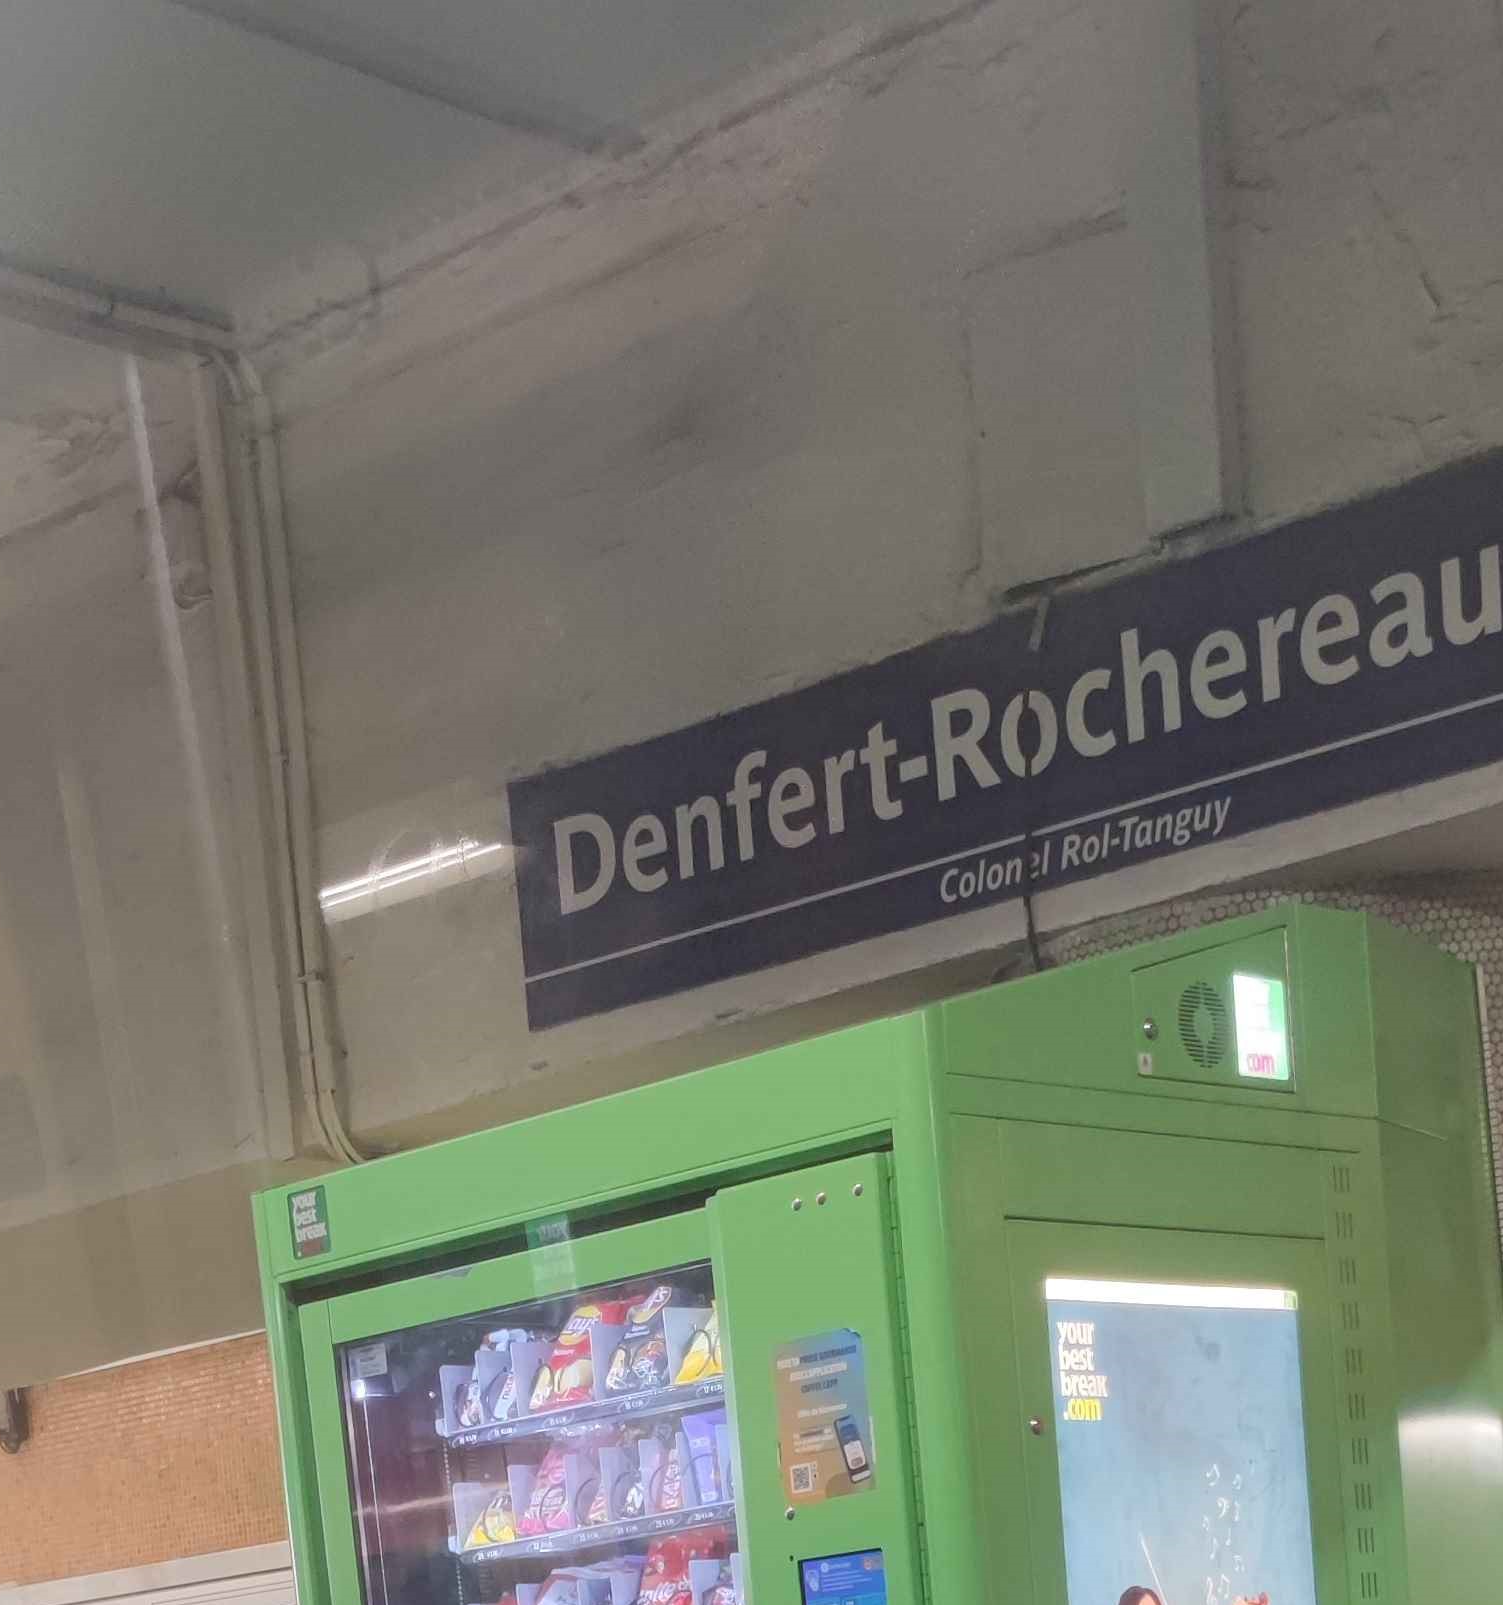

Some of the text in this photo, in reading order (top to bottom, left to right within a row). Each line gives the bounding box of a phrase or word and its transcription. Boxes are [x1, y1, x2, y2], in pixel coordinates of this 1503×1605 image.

[939, 796, 1232, 904] Colonel Rol-Tanguy
[1056, 1322, 1095, 1345] your
[1058, 1342, 1095, 1371] best
[1060, 1371, 1108, 1397] break
[1064, 1397, 1102, 1421] .com
